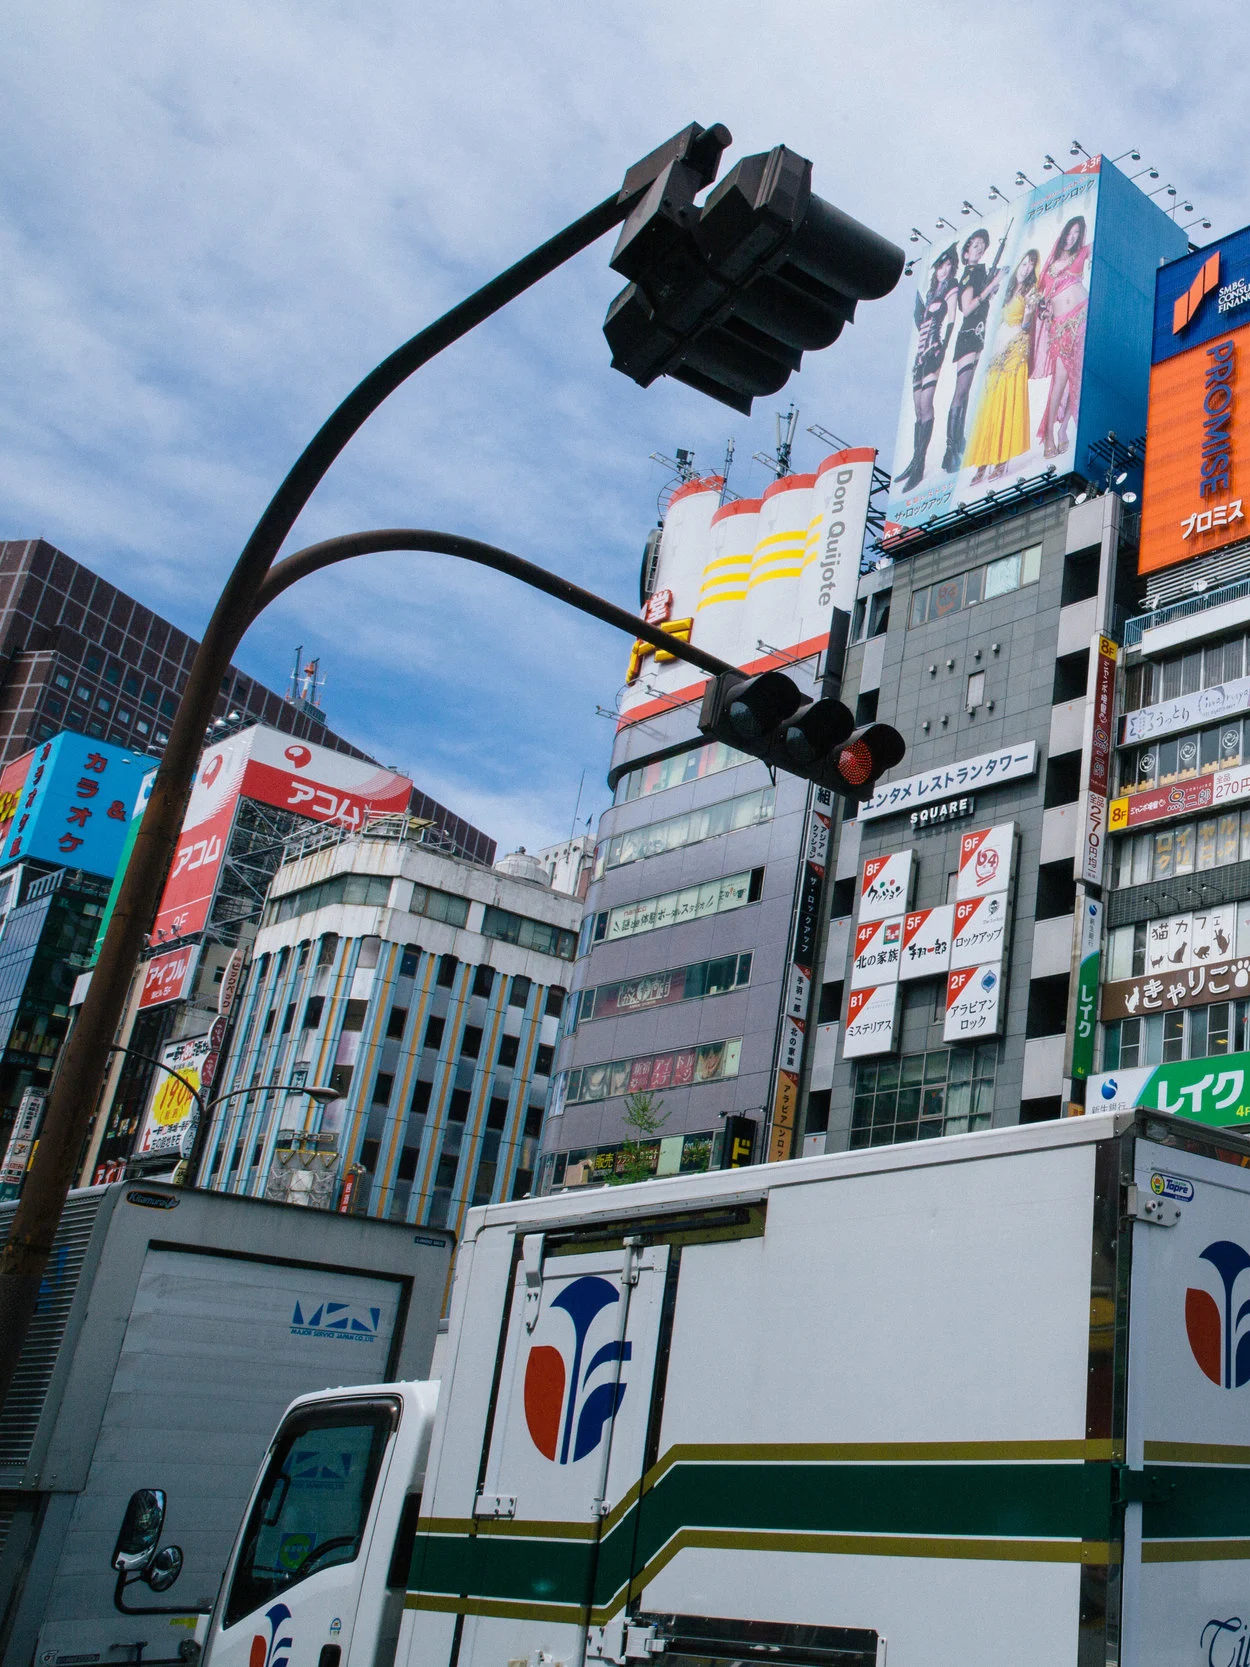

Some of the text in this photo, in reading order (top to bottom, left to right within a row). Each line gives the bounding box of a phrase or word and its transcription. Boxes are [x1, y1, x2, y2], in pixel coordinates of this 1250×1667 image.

[1218, 278, 1245, 297] SMBC
[1200, 339, 1234, 498] PROMISE
[1181, 499, 1245, 540] プロミス
[818, 469, 854, 607] Don Quijote
[1100, 639, 1115, 657] 8F
[861, 754, 1029, 811] エンタメ レストランタワー
[1216, 773, 1231, 785] 全品
[59, 752, 108, 853] カラオケ
[107, 800, 126, 822] &
[288, 781, 360, 825] アコム
[909, 799, 968, 824] SQUARE
[1112, 807, 1127, 822] 8F
[963, 836, 979, 852] 9F
[171, 834, 222, 879] アコム
[866, 862, 880, 877] 8F
[957, 904, 973, 918] 6F
[906, 916, 921, 930] 5F
[1151, 915, 1222, 941] 猫カフェ
[858, 927, 873, 941] 4F
[955, 926, 1004, 948] ロックアップ
[855, 948, 899, 969] 北の家族
[145, 958, 188, 989] アイフル
[951, 974, 966, 989] 2F
[1142, 964, 1230, 1008] きゃりこ
[850, 992, 864, 1008] B1
[950, 999, 997, 1018] アラビアン
[1078, 984, 1094, 1037] レイク
[847, 1019, 892, 1037] ミステリアス
[960, 1015, 987, 1030] ロック
[1157, 1069, 1245, 1114] レイク
[1235, 1104, 1250, 1118] 4F
[776, 1084, 791, 1162] アラビアンロッ
[1165, 1178, 1189, 1194] Topre
